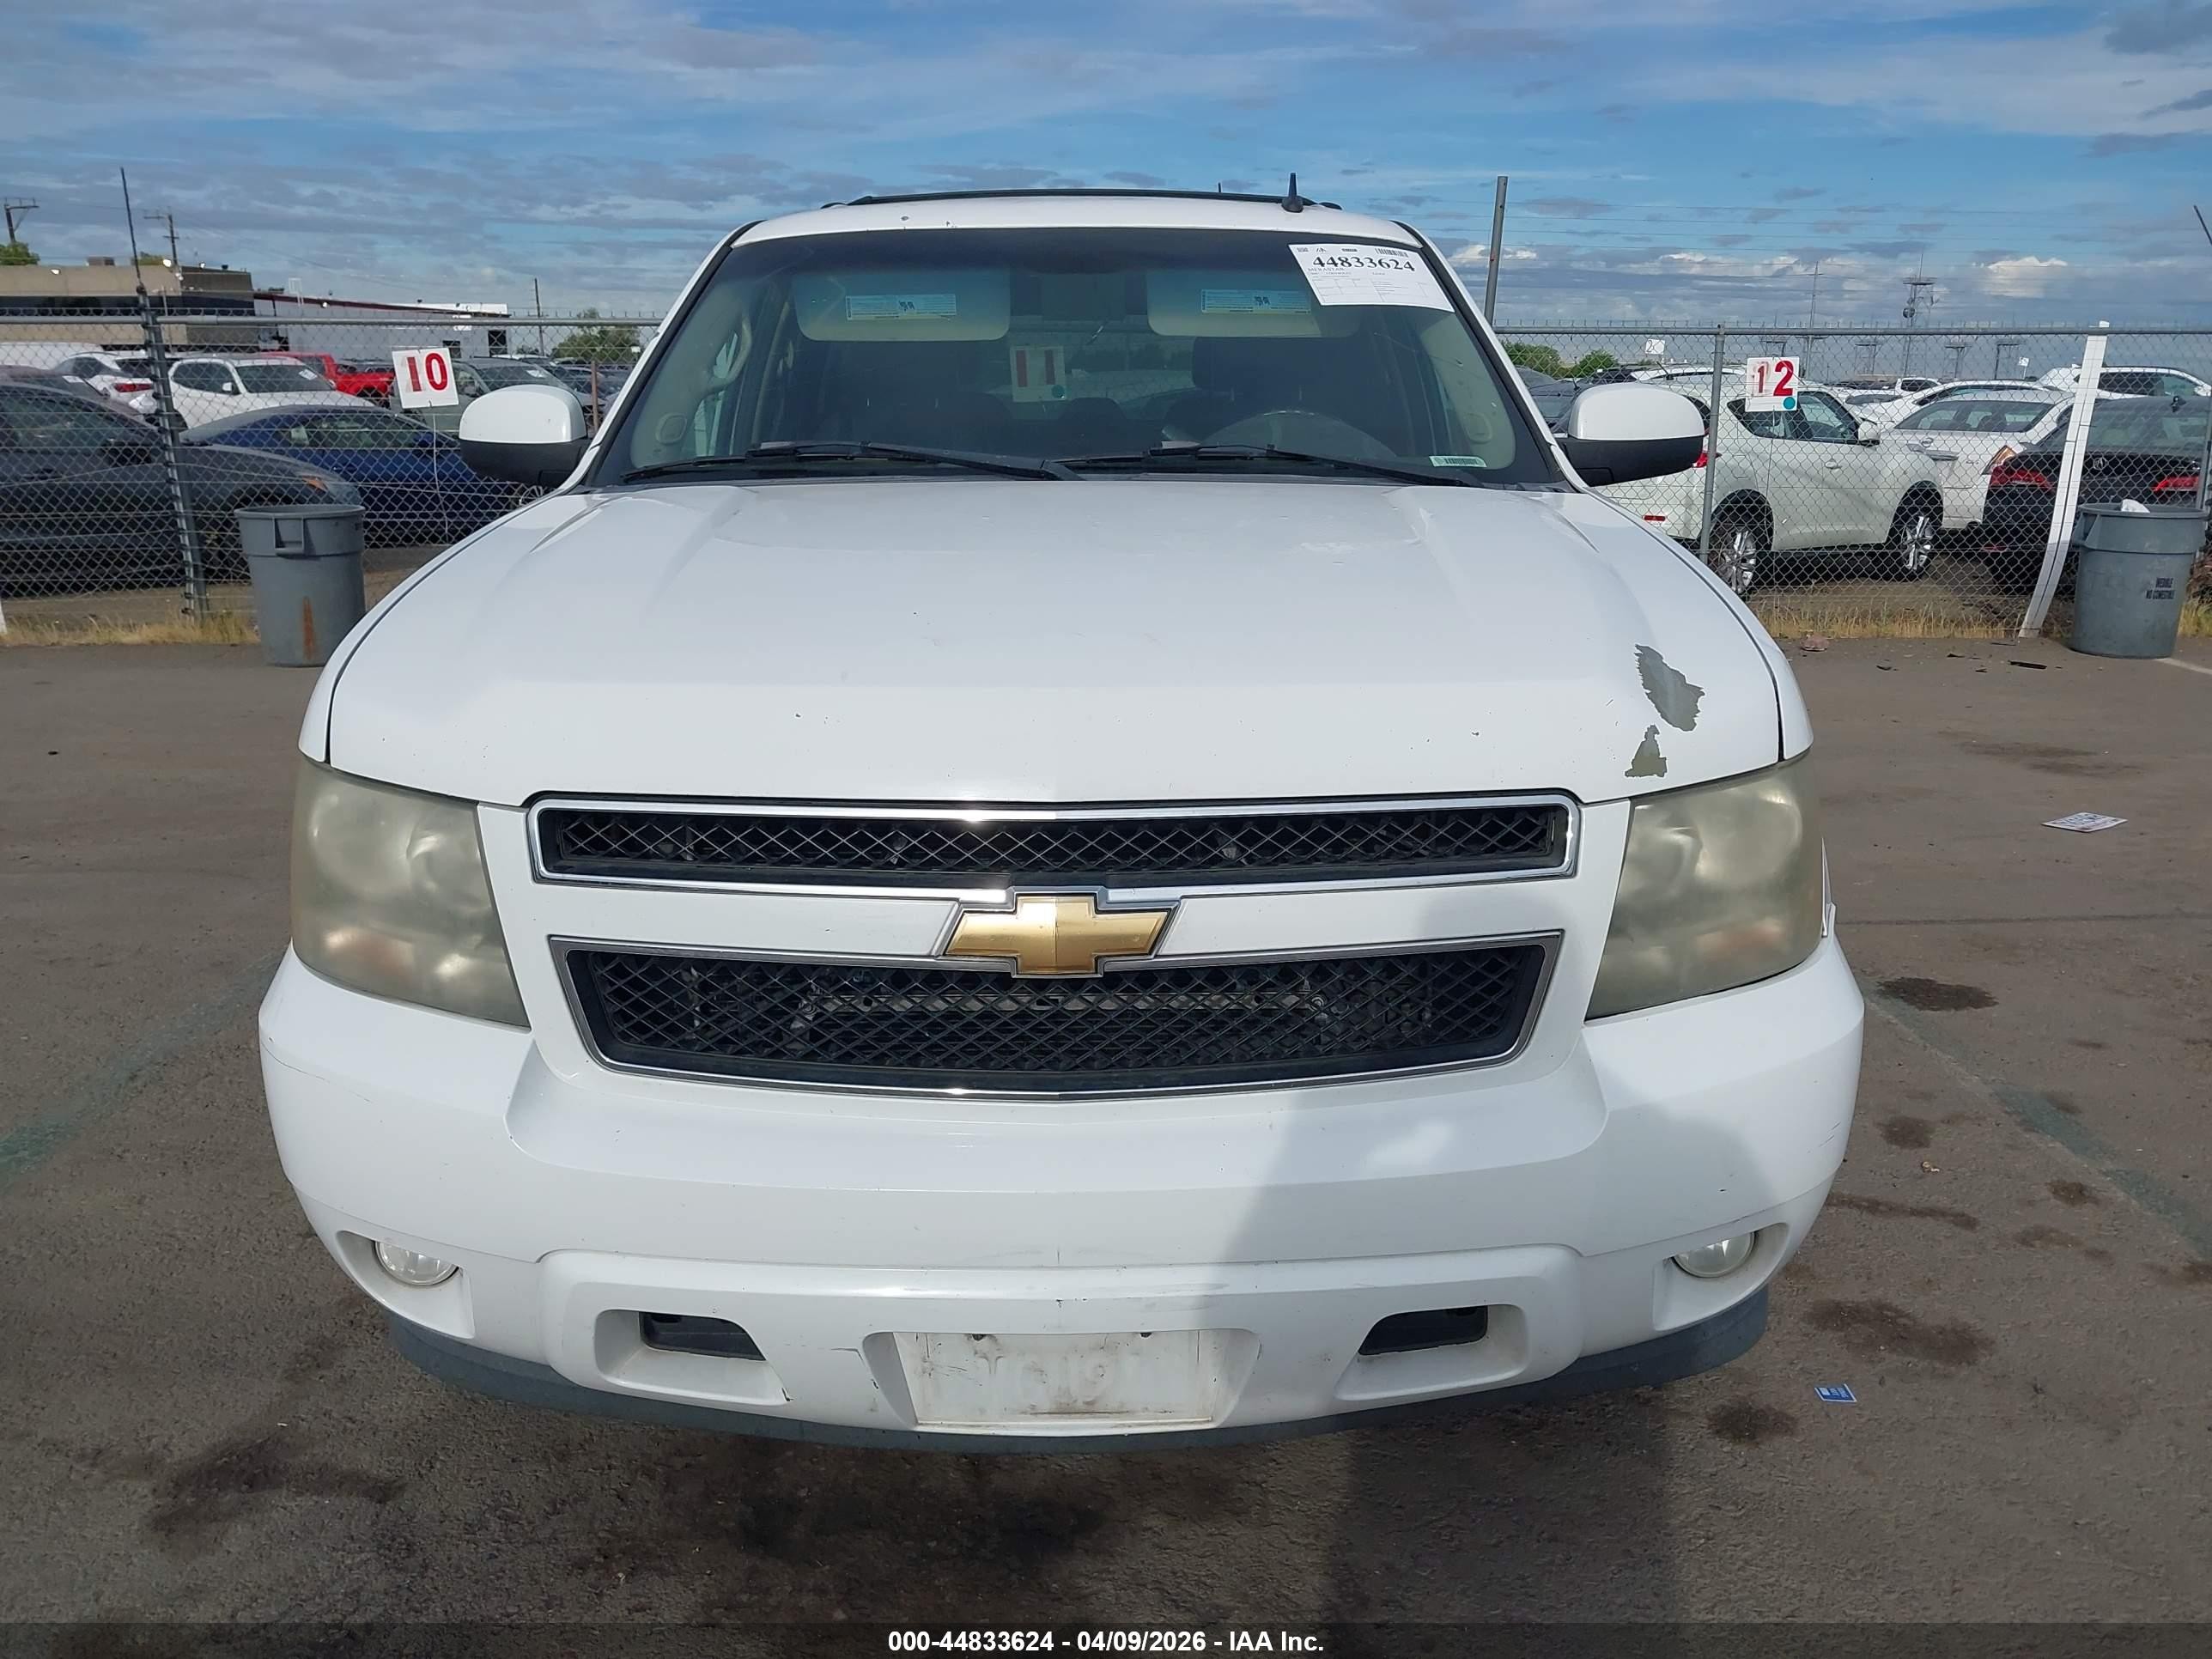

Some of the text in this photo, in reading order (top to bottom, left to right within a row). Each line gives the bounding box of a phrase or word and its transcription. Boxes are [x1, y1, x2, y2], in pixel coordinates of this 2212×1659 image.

[1313, 256, 1415, 271] 44833624
[407, 353, 448, 391] 10
[1758, 361, 1794, 397] 12
